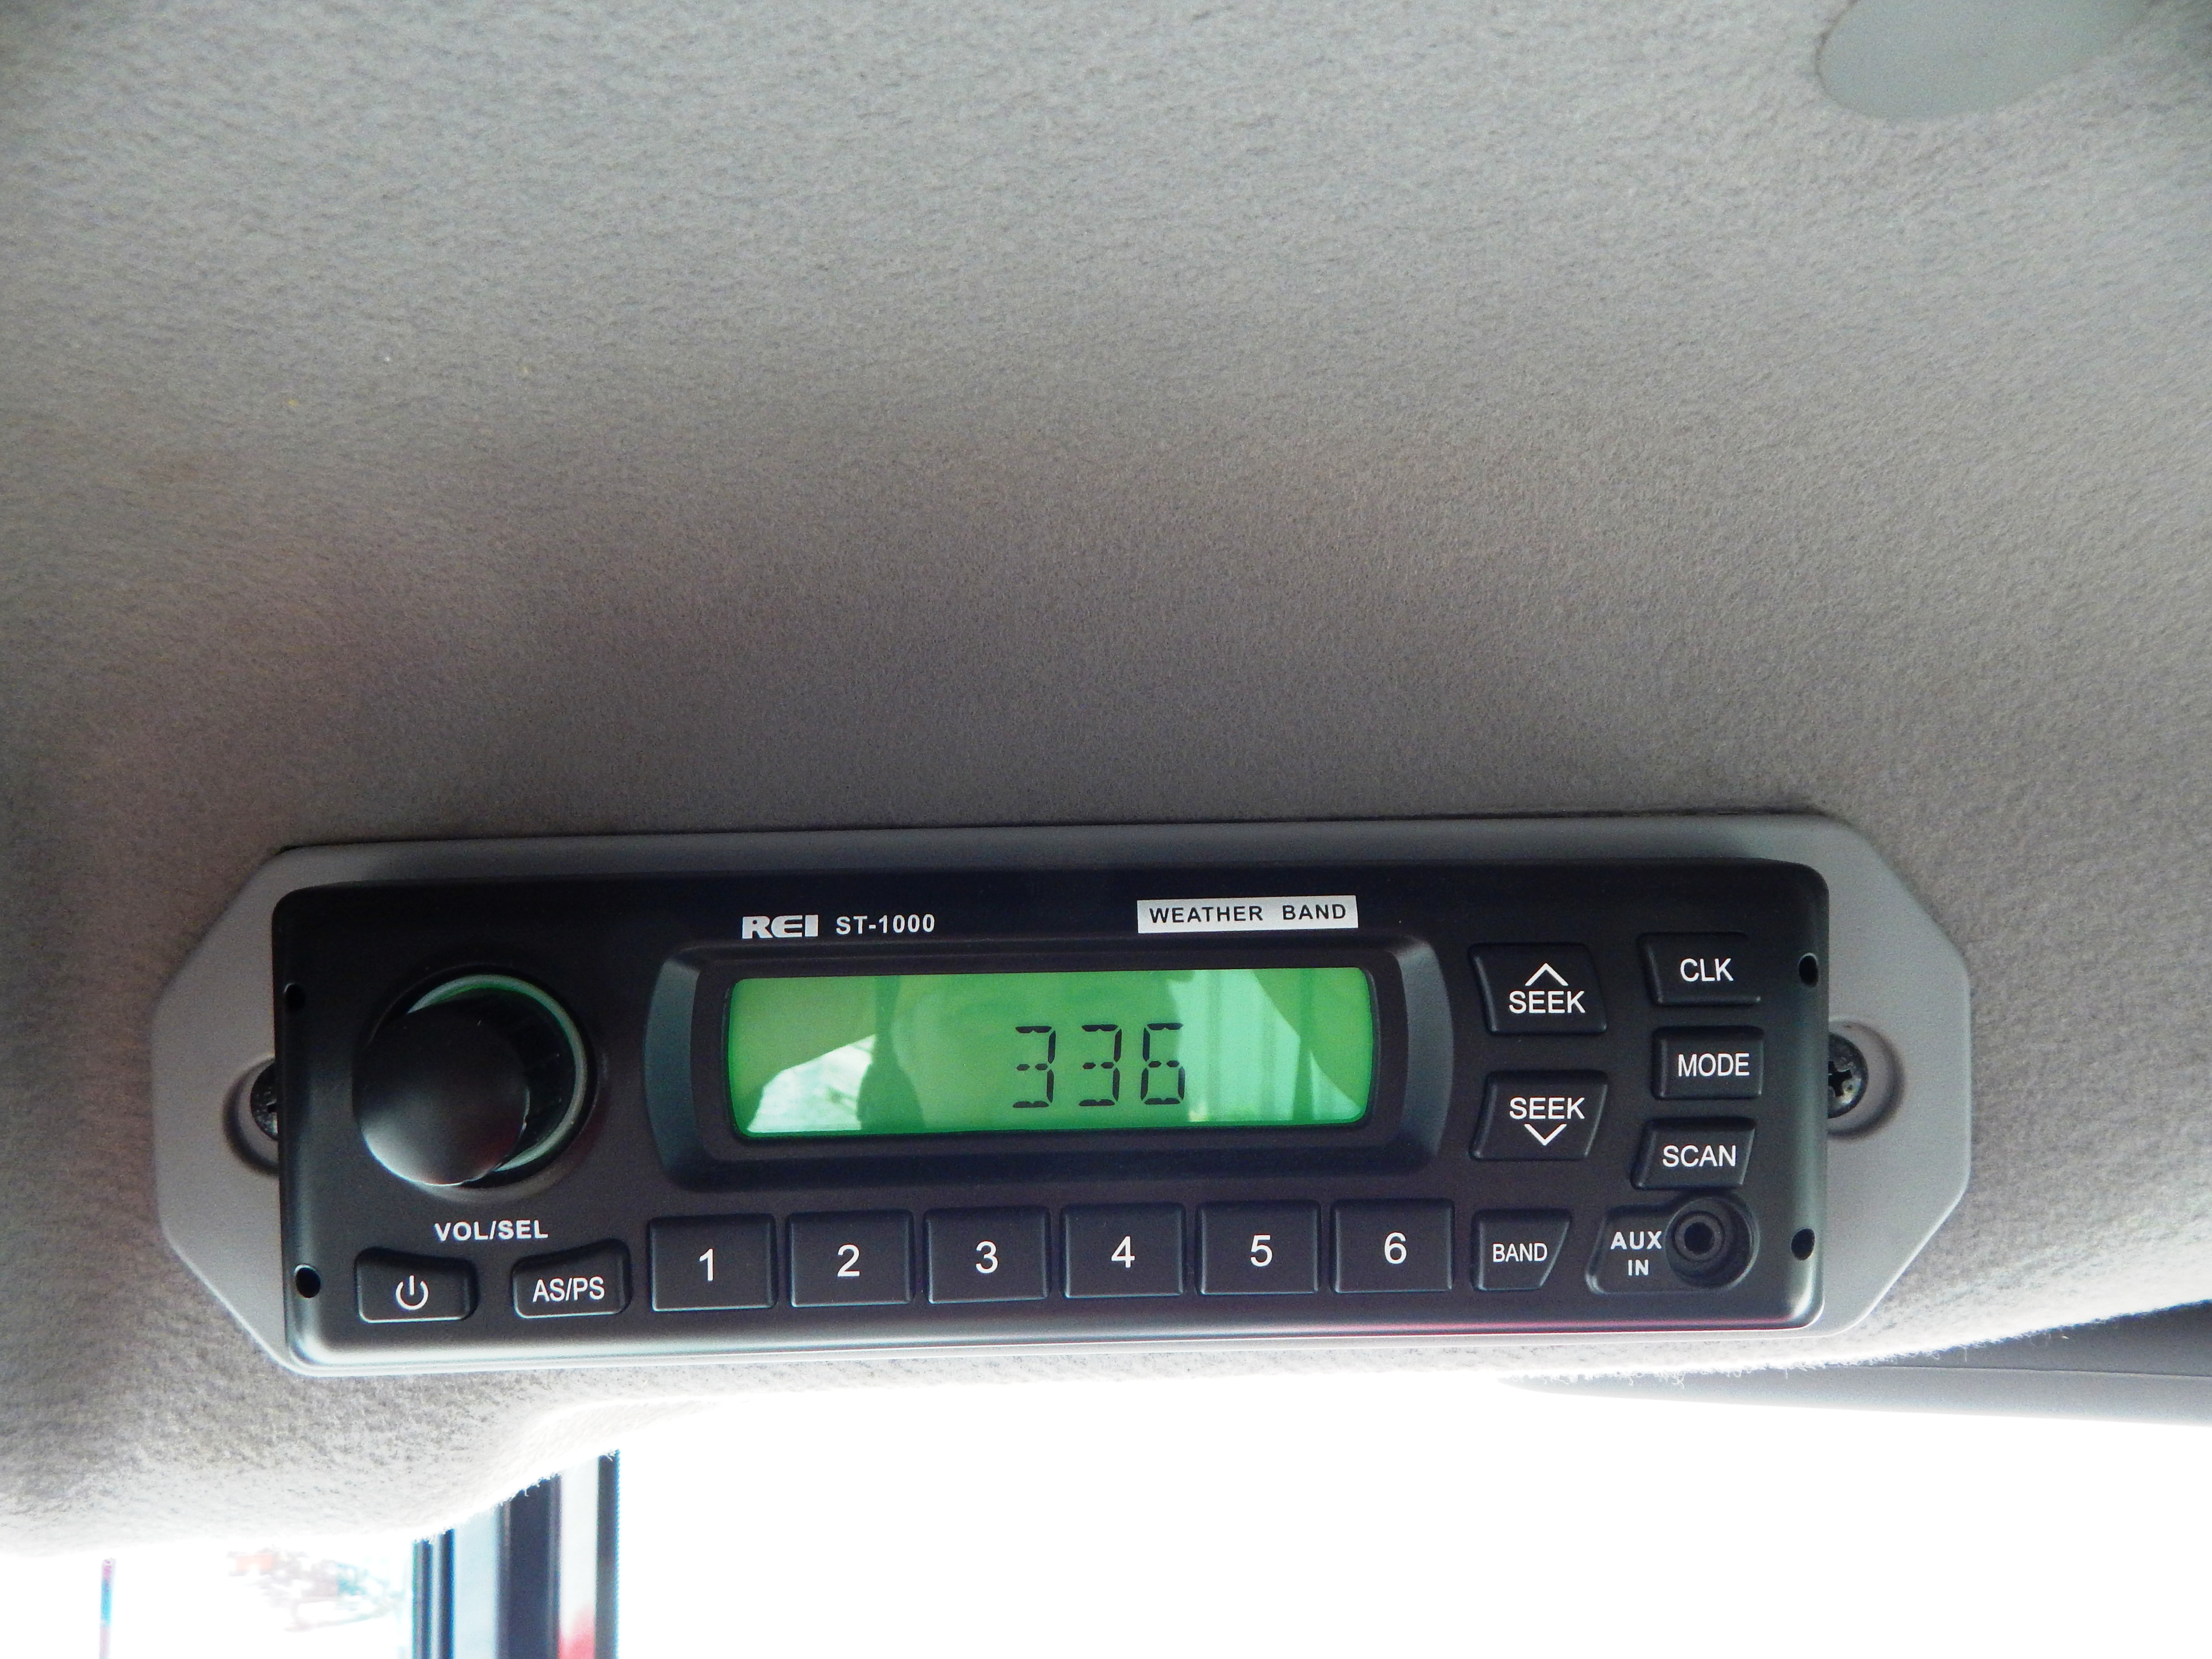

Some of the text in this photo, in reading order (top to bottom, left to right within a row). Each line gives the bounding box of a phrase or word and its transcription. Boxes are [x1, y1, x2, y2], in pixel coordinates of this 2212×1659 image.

[1149, 903, 1346, 924] WEATHER BAND
[741, 914, 935, 940] REI ST-1000
[1680, 958, 1734, 983] CLK
[1508, 990, 1586, 1014] SEEK
[1012, 1022, 1186, 1109] 336
[1678, 1052, 1750, 1078] MODE
[1509, 1096, 1586, 1120] SEEK
[1662, 1144, 1737, 1168] SCAN
[433, 1219, 549, 1242] VOL/SEL
[1610, 1230, 1662, 1250] AUX
[837, 1244, 860, 1278] 2
[975, 1240, 998, 1274] 3
[1110, 1236, 1136, 1268] 4
[1250, 1234, 1273, 1267] 5
[1383, 1232, 1407, 1265] 6
[1492, 1242, 1548, 1263] BAND
[698, 1248, 714, 1282] 1
[1627, 1259, 1649, 1276] IN
[532, 1276, 605, 1303] AS/PS
